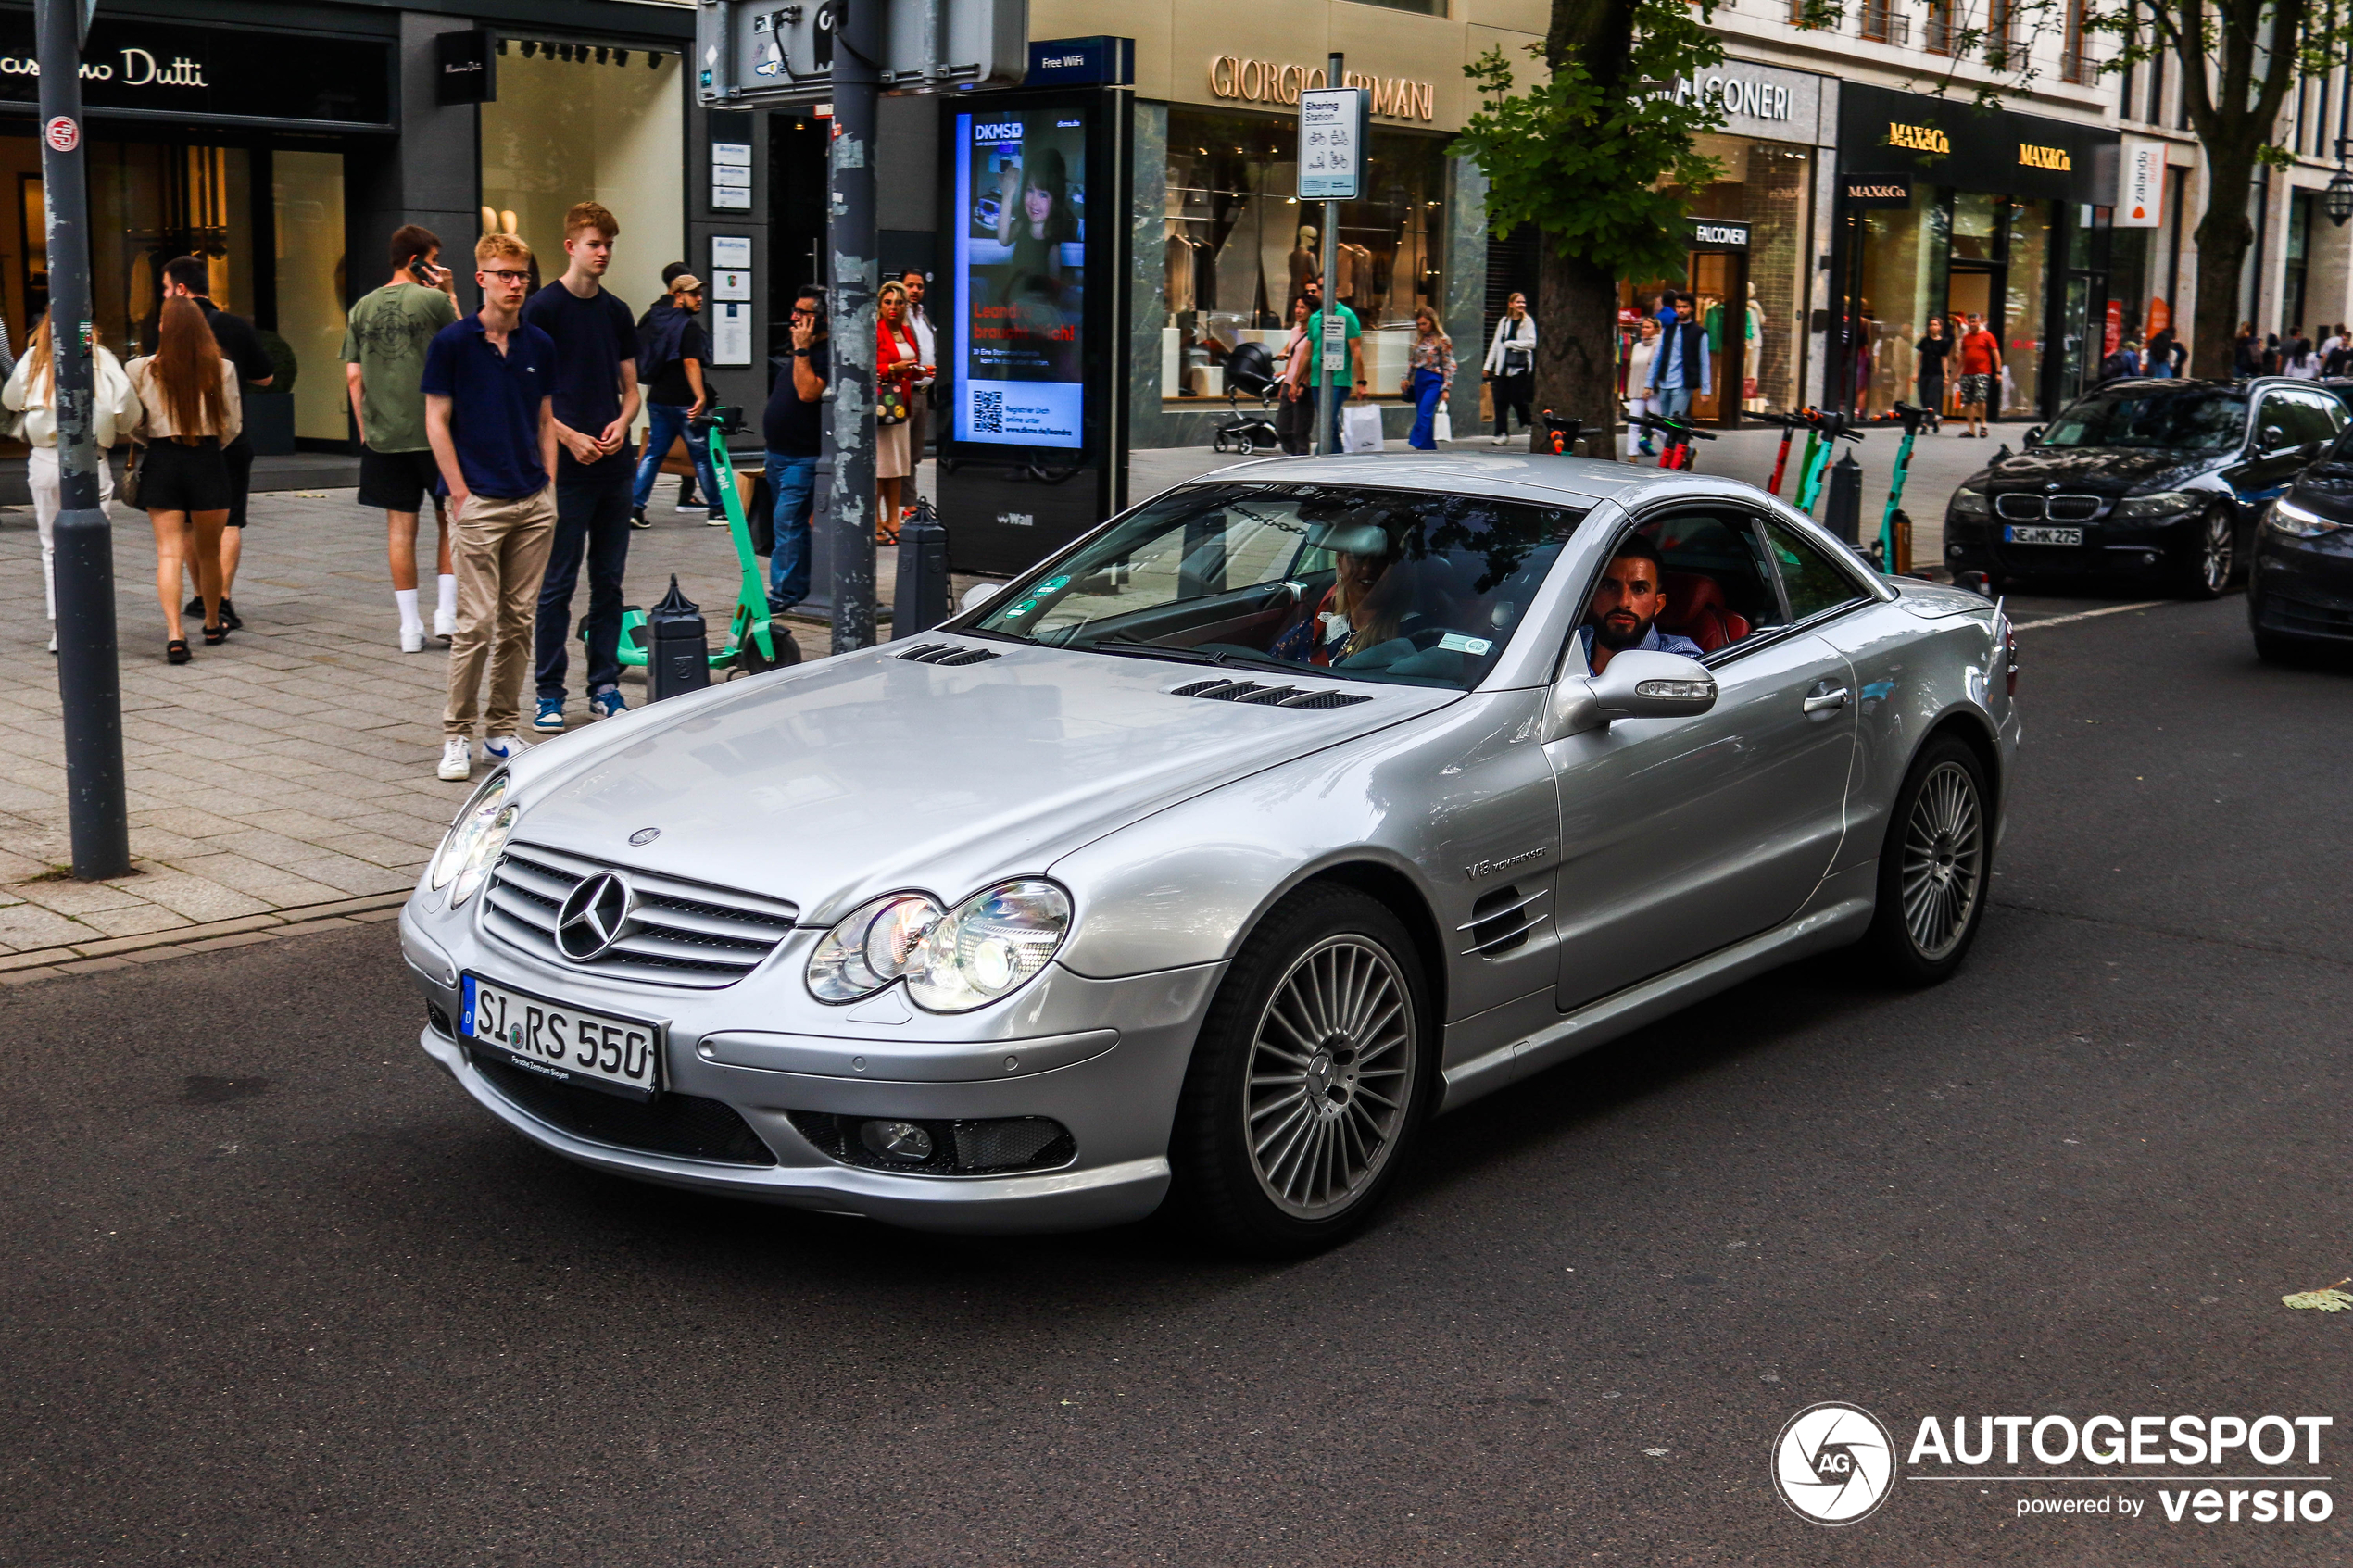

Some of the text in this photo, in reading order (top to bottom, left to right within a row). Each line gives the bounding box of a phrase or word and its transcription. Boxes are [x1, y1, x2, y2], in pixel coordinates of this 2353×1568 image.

[119, 48, 208, 87] Dutti
[1042, 55, 1084, 69] Free WiFi
[1305, 101, 1339, 111] Sharing
[1305, 112, 1335, 121] Station
[975, 123, 1012, 140] DKMS
[2134, 151, 2148, 203] zalando
[715, 466, 731, 491] Bolt
[1009, 513, 1033, 526] Wall
[2012, 528, 2027, 541] NE
[2056, 530, 2080, 544] 275
[1466, 859, 1491, 881] V8
[465, 1010, 472, 1024] D
[478, 989, 648, 1080] SI RS 550
